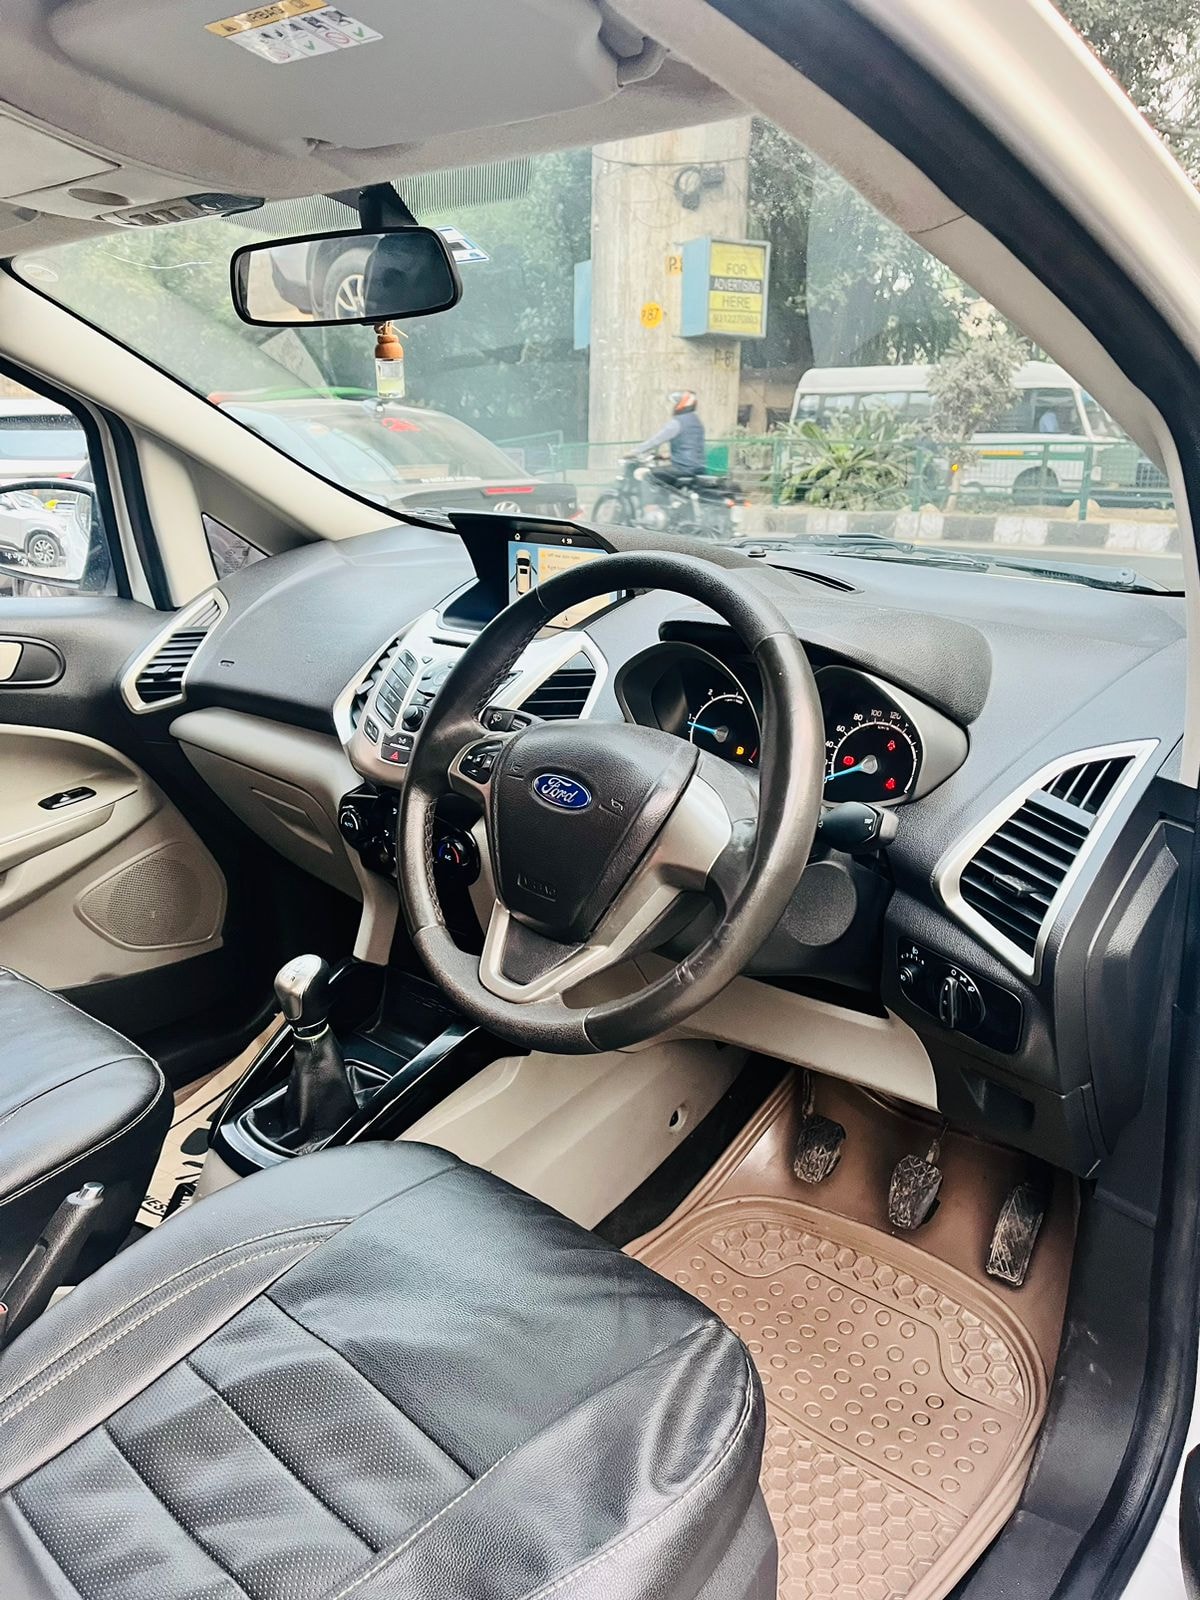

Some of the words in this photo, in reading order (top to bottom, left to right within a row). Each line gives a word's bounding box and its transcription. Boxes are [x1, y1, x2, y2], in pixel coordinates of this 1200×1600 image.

[726, 263, 748, 276] FOR
[713, 278, 761, 294] ADVERTISING
[722, 295, 751, 310] HERE
[853, 712, 863, 721] 80
[870, 708, 882, 717] 100
[890, 711, 902, 720] 120
[836, 724, 846, 733] 60
[825, 740, 834, 748] 40
[541, 776, 579, 803] Ford
